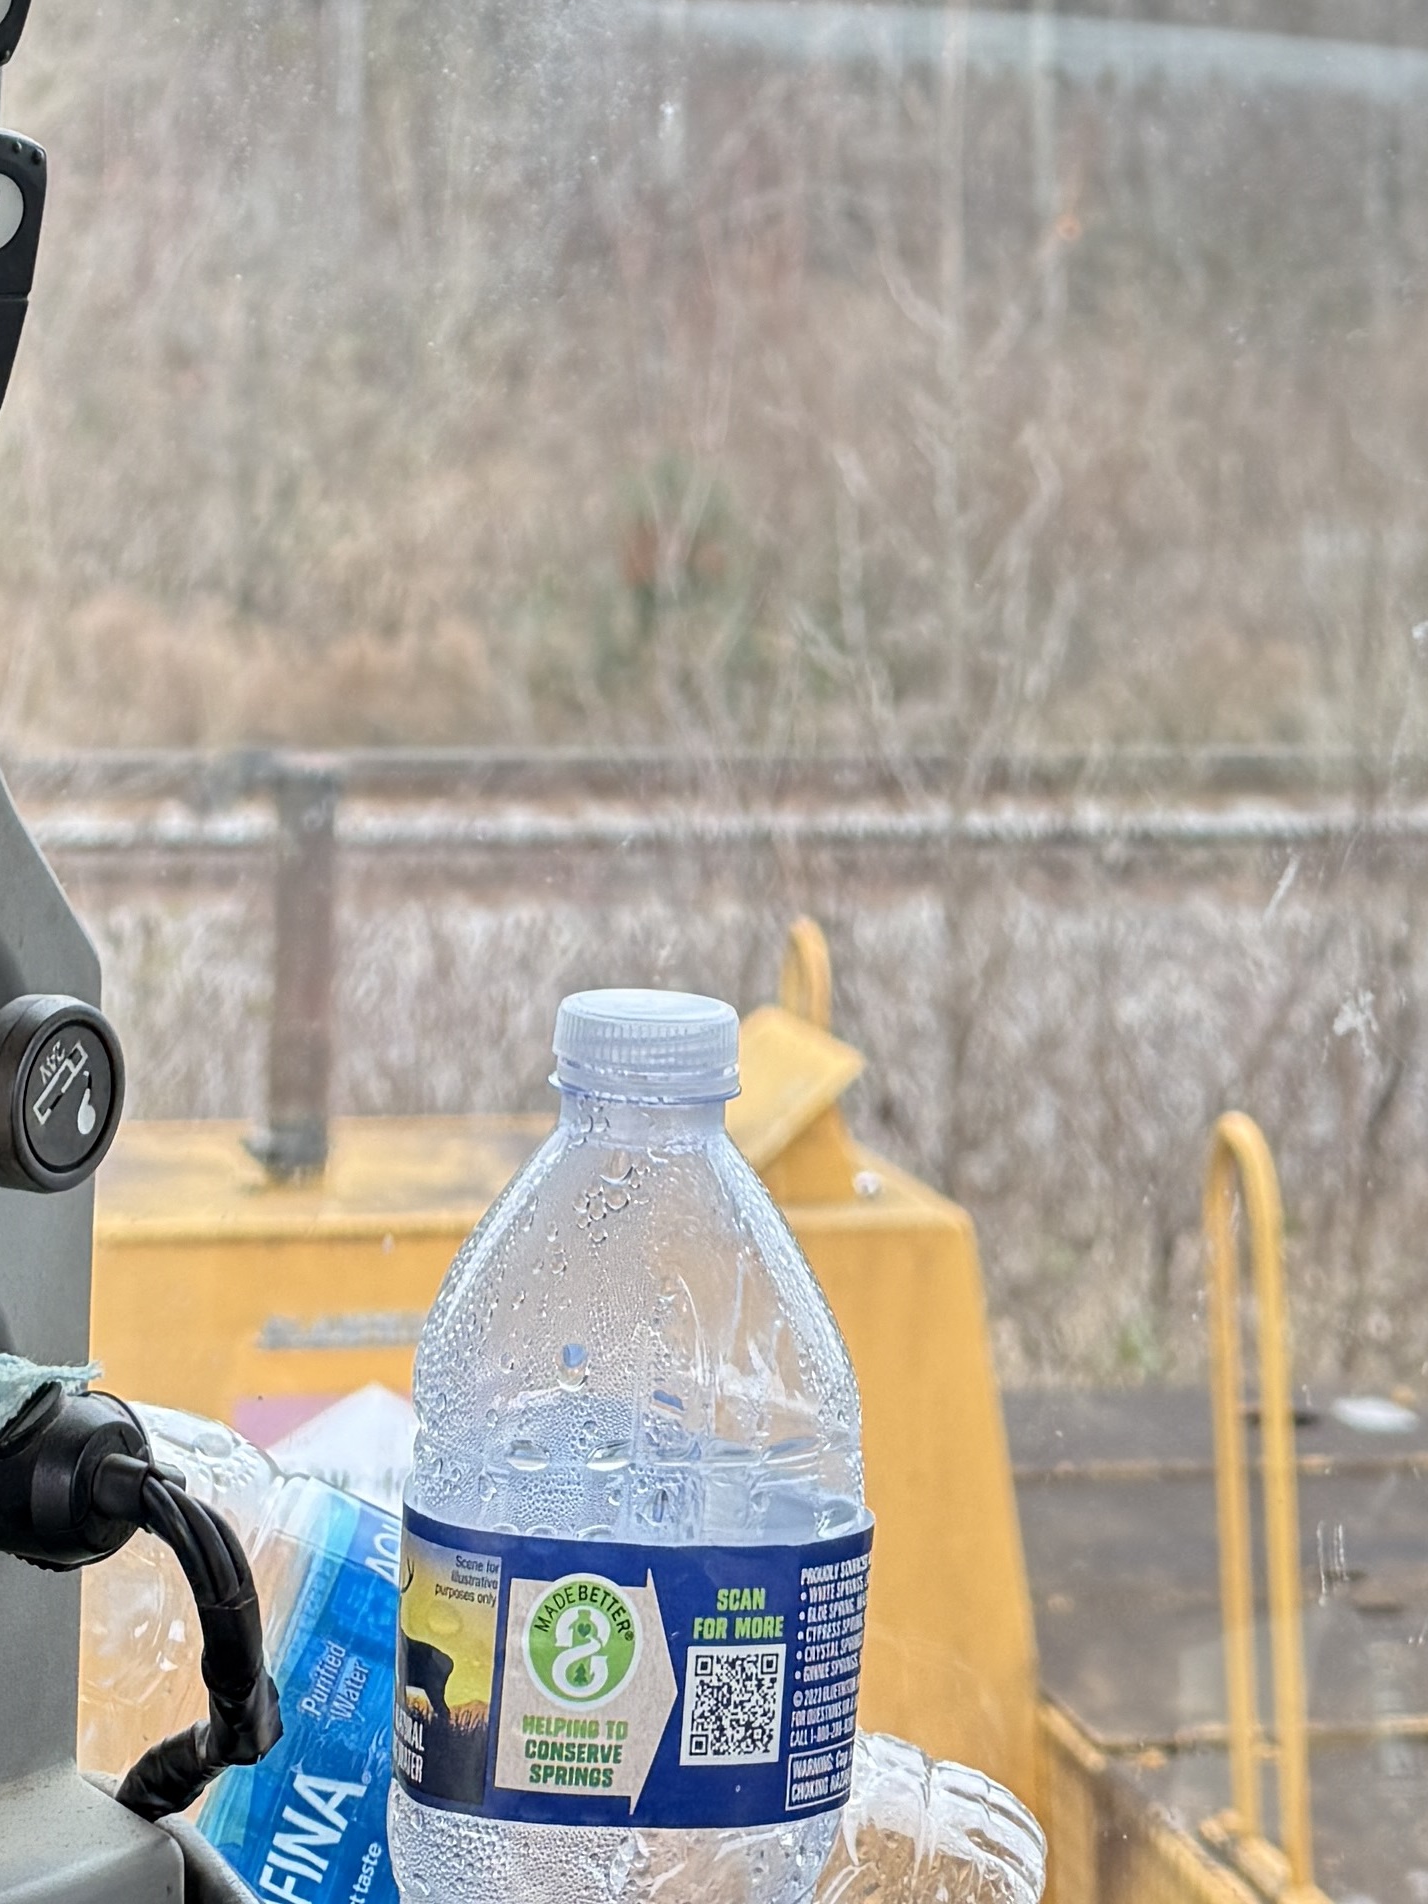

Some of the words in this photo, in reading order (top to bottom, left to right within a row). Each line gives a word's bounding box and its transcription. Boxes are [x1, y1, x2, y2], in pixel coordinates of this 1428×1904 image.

[455, 1554, 484, 1572] Scene
[486, 1559, 500, 1574] for
[435, 1583, 475, 1603] purposes
[477, 1592, 497, 1608] only
[716, 1587, 766, 1611] SCAN
[533, 1586, 576, 1633] MADE
[693, 1616, 728, 1640] FOR
[734, 1615, 785, 1640] MORE
[300, 1640, 346, 1717] Purified
[330, 1660, 369, 1719] Water
[522, 1713, 600, 1740] HELPING
[606, 1719, 629, 1741] TO
[790, 1728, 808, 1747] CALL
[524, 1738, 623, 1764] CONSERVE
[529, 1763, 614, 1788] SPRINGS
[259, 1773, 368, 1904] FINA
[353, 1841, 382, 1894] taste
